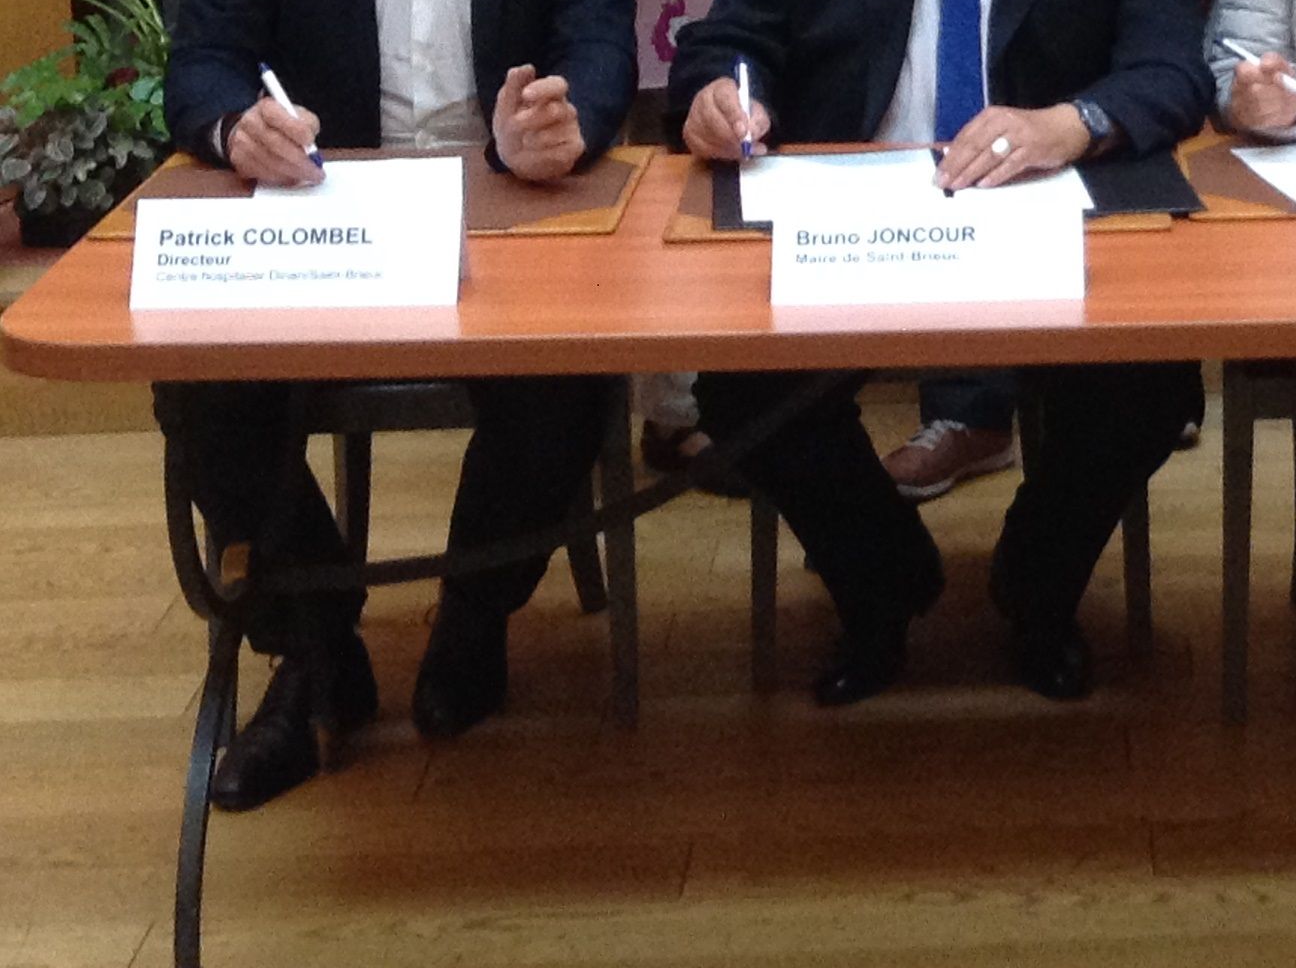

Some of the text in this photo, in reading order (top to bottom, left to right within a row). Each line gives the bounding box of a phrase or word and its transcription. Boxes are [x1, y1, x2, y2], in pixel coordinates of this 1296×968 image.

[159, 227, 372, 246] Patrick COLOMBEL
[796, 226, 976, 246] Bruno JONCOUR
[157, 253, 231, 266] Directeur
[796, 253, 837, 264] Maire
[843, 253, 860, 263] de
